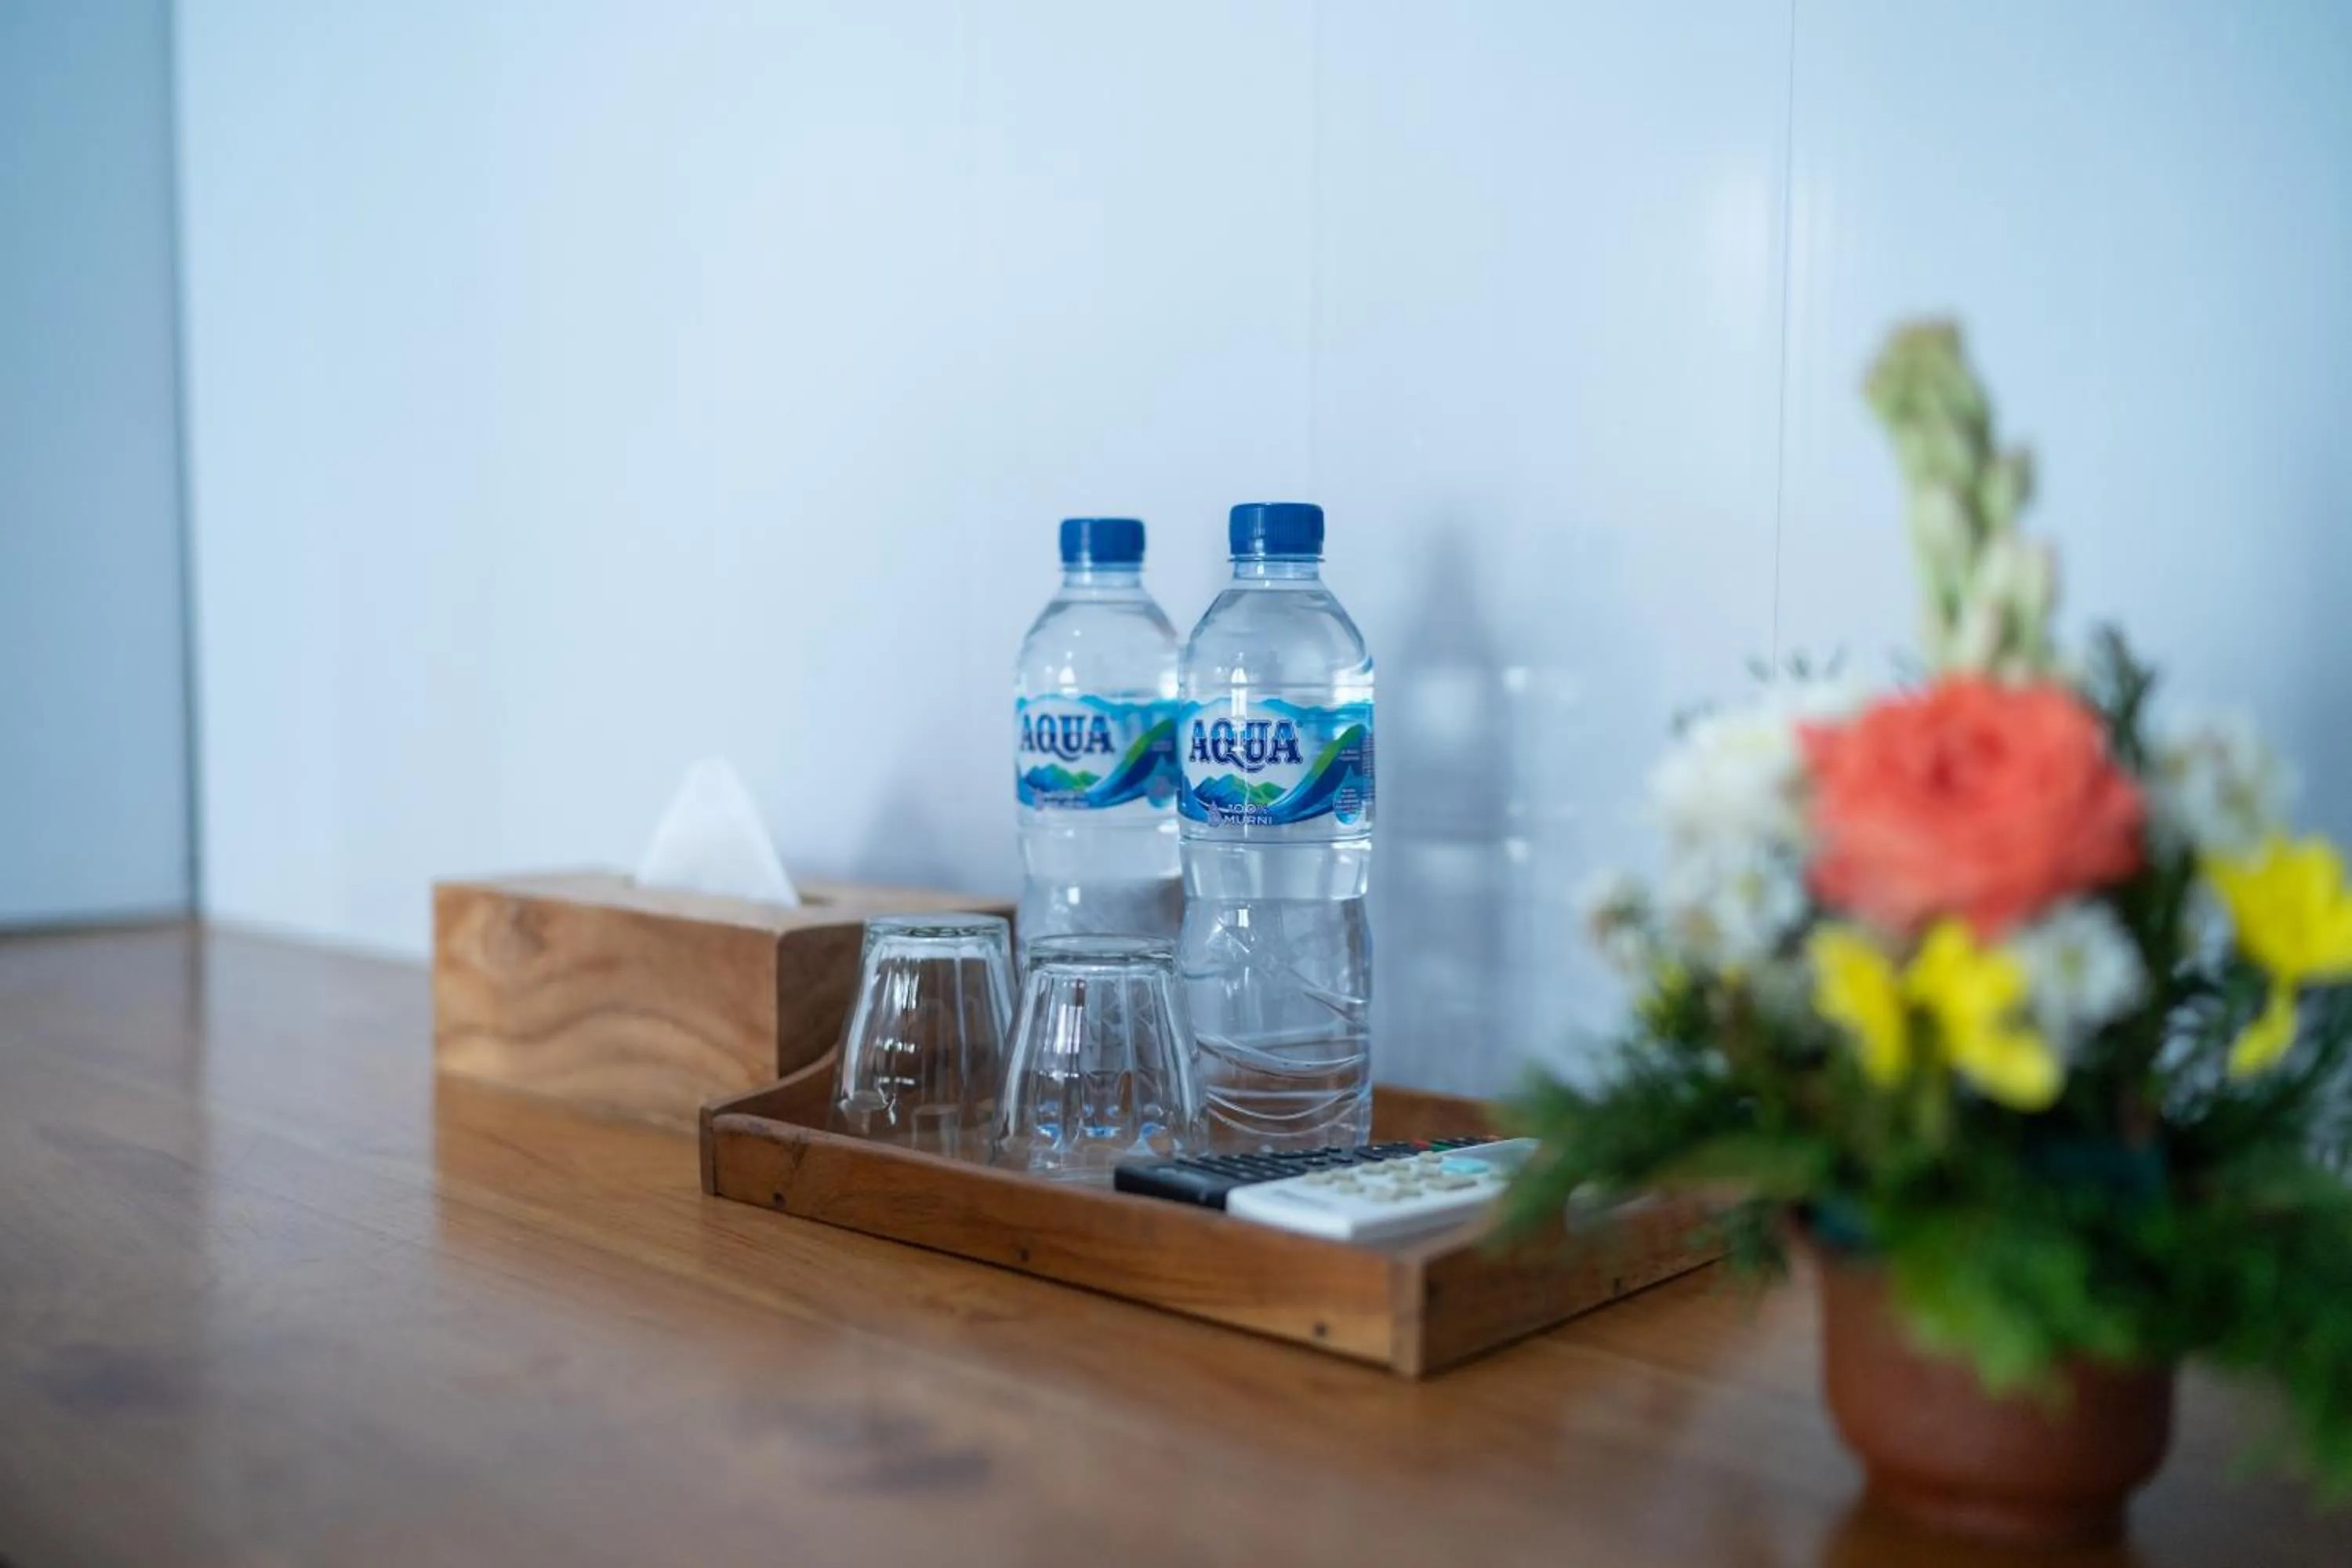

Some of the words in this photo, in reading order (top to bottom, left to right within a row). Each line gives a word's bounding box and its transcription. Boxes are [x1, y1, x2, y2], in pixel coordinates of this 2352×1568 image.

[1021, 713, 1116, 762] AQUA
[1189, 717, 1304, 773] AQUA
[1224, 815, 1272, 826] MURNI
